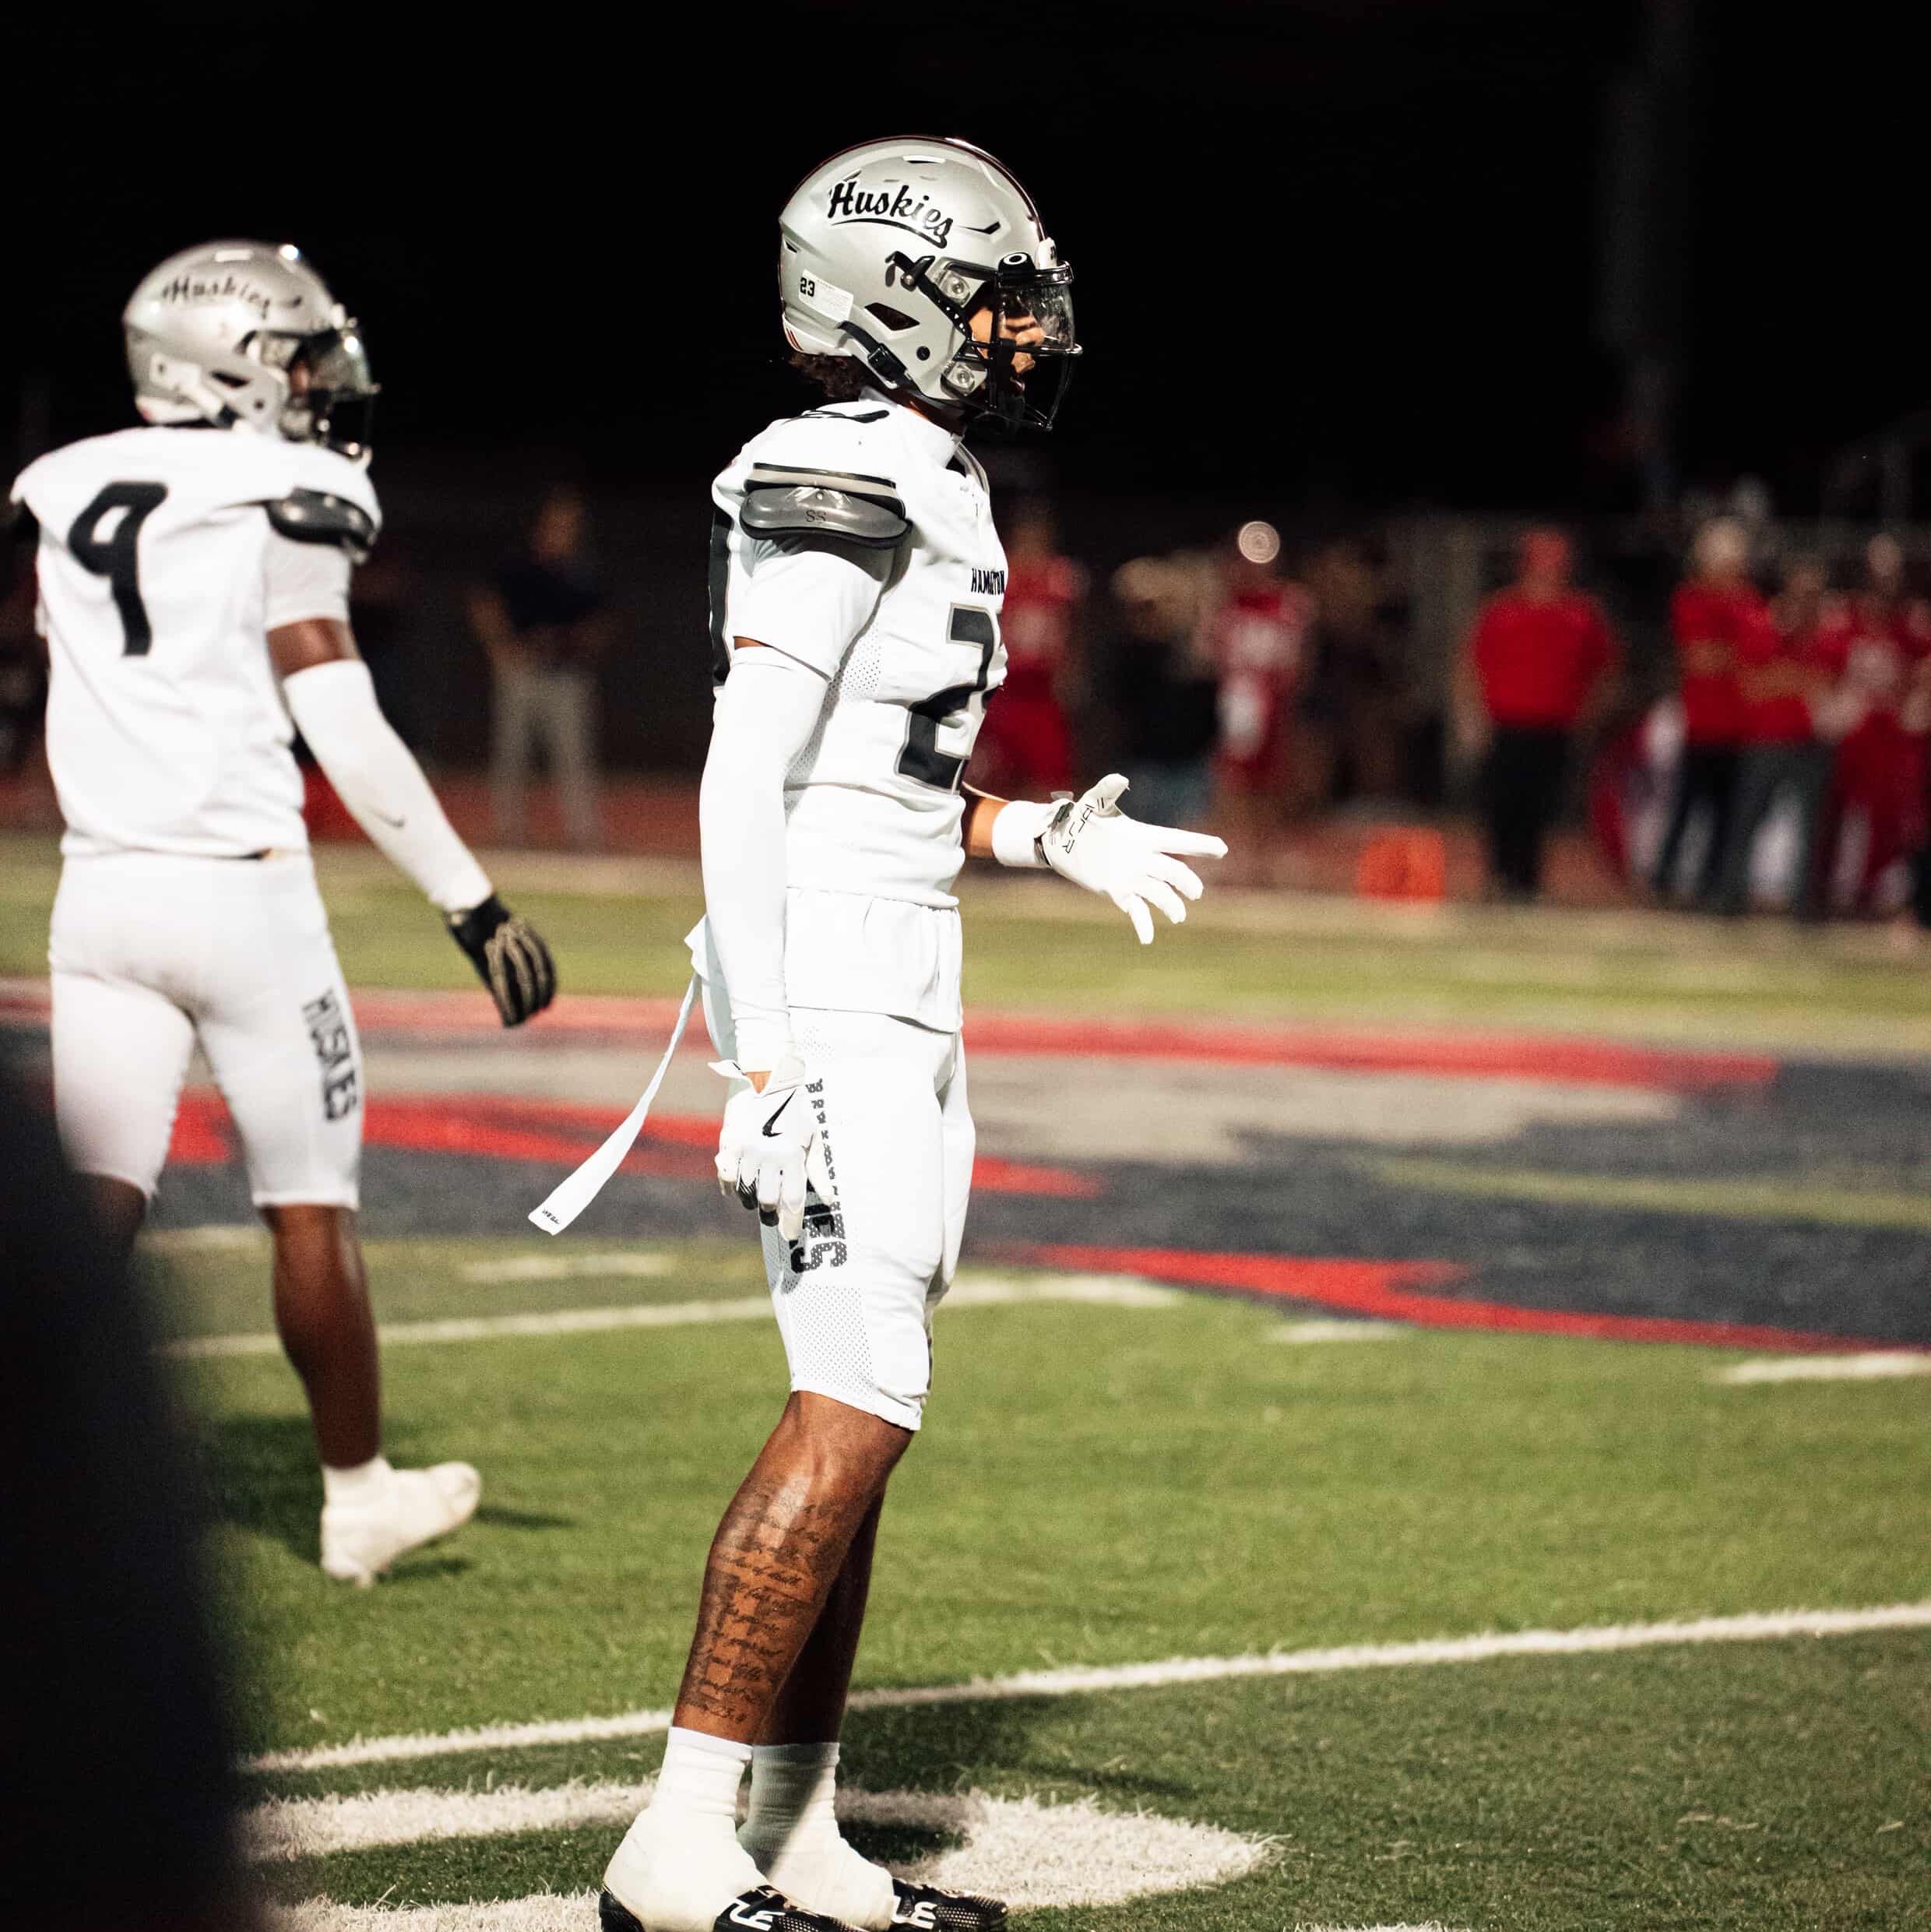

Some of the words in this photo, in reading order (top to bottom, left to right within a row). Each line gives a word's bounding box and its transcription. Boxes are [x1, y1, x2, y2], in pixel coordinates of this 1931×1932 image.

[827, 181, 953, 248] Huskies
[800, 277, 815, 297] 23
[68, 480, 169, 656] 9
[895, 603, 1001, 795] 2
